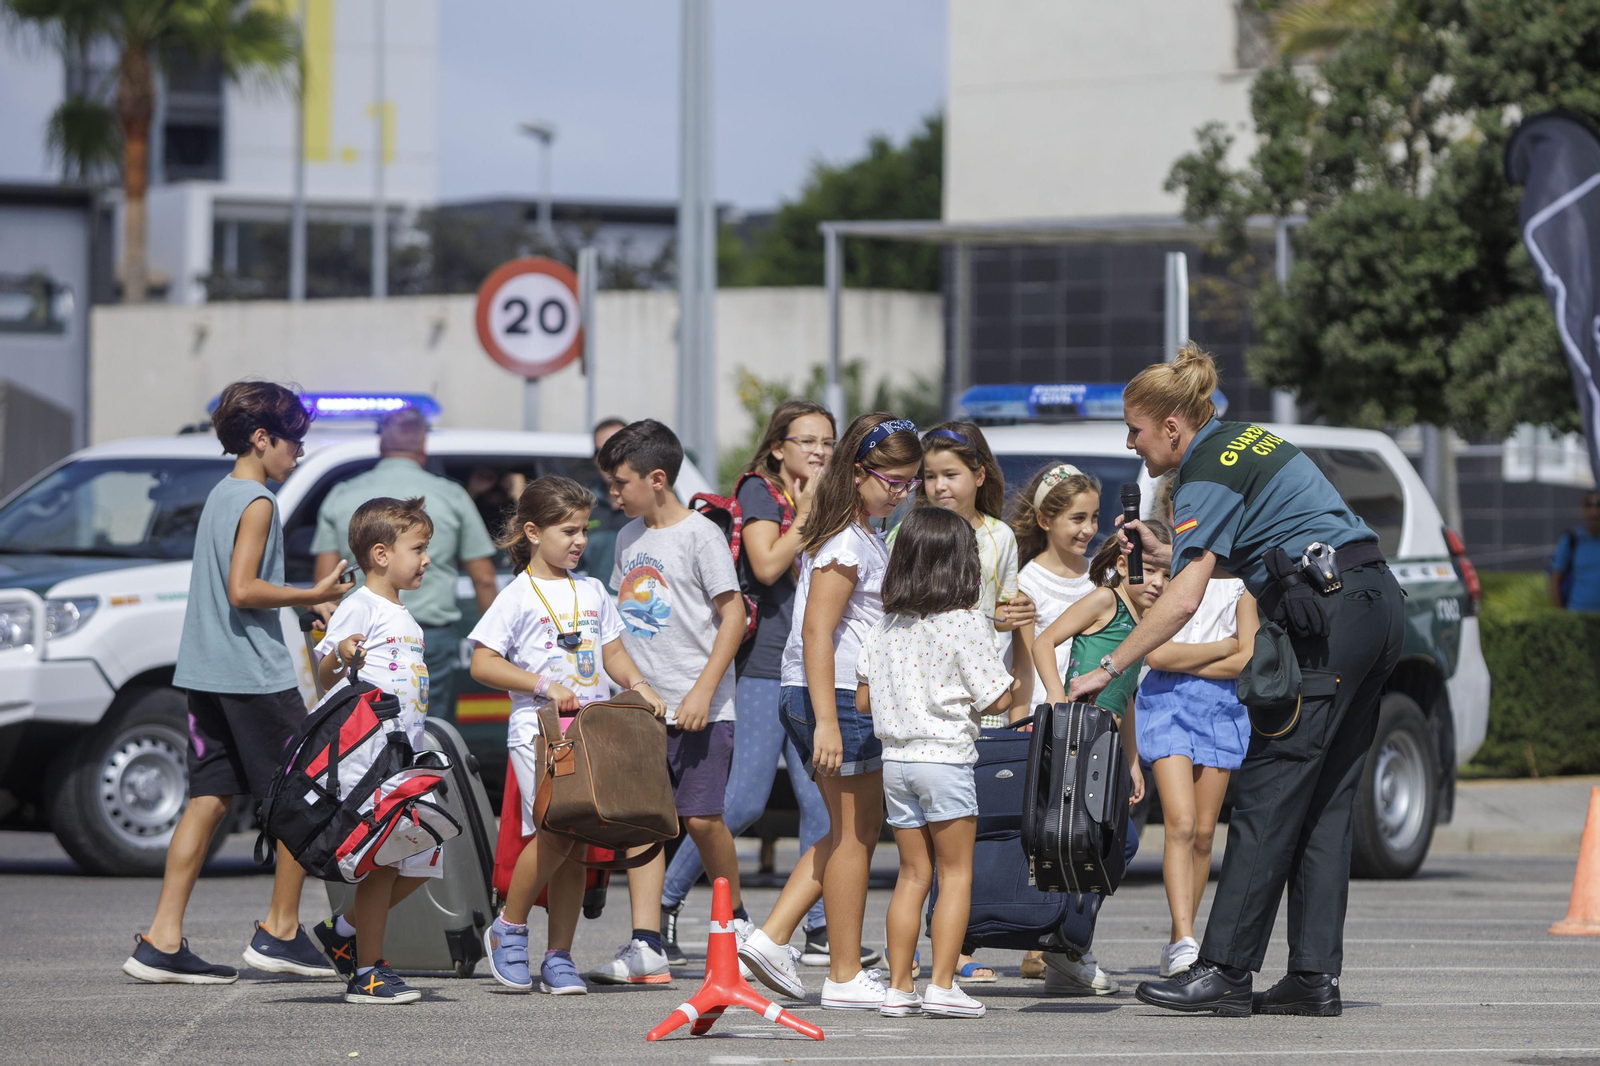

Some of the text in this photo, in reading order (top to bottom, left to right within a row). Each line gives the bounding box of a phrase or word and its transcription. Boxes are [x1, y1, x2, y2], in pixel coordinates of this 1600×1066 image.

[503, 298, 567, 335] 20
[1219, 424, 1267, 467] GUARDI
[1251, 433, 1284, 456] CIVIL
[623, 552, 664, 576] California
[626, 569, 649, 586] SUNSET
